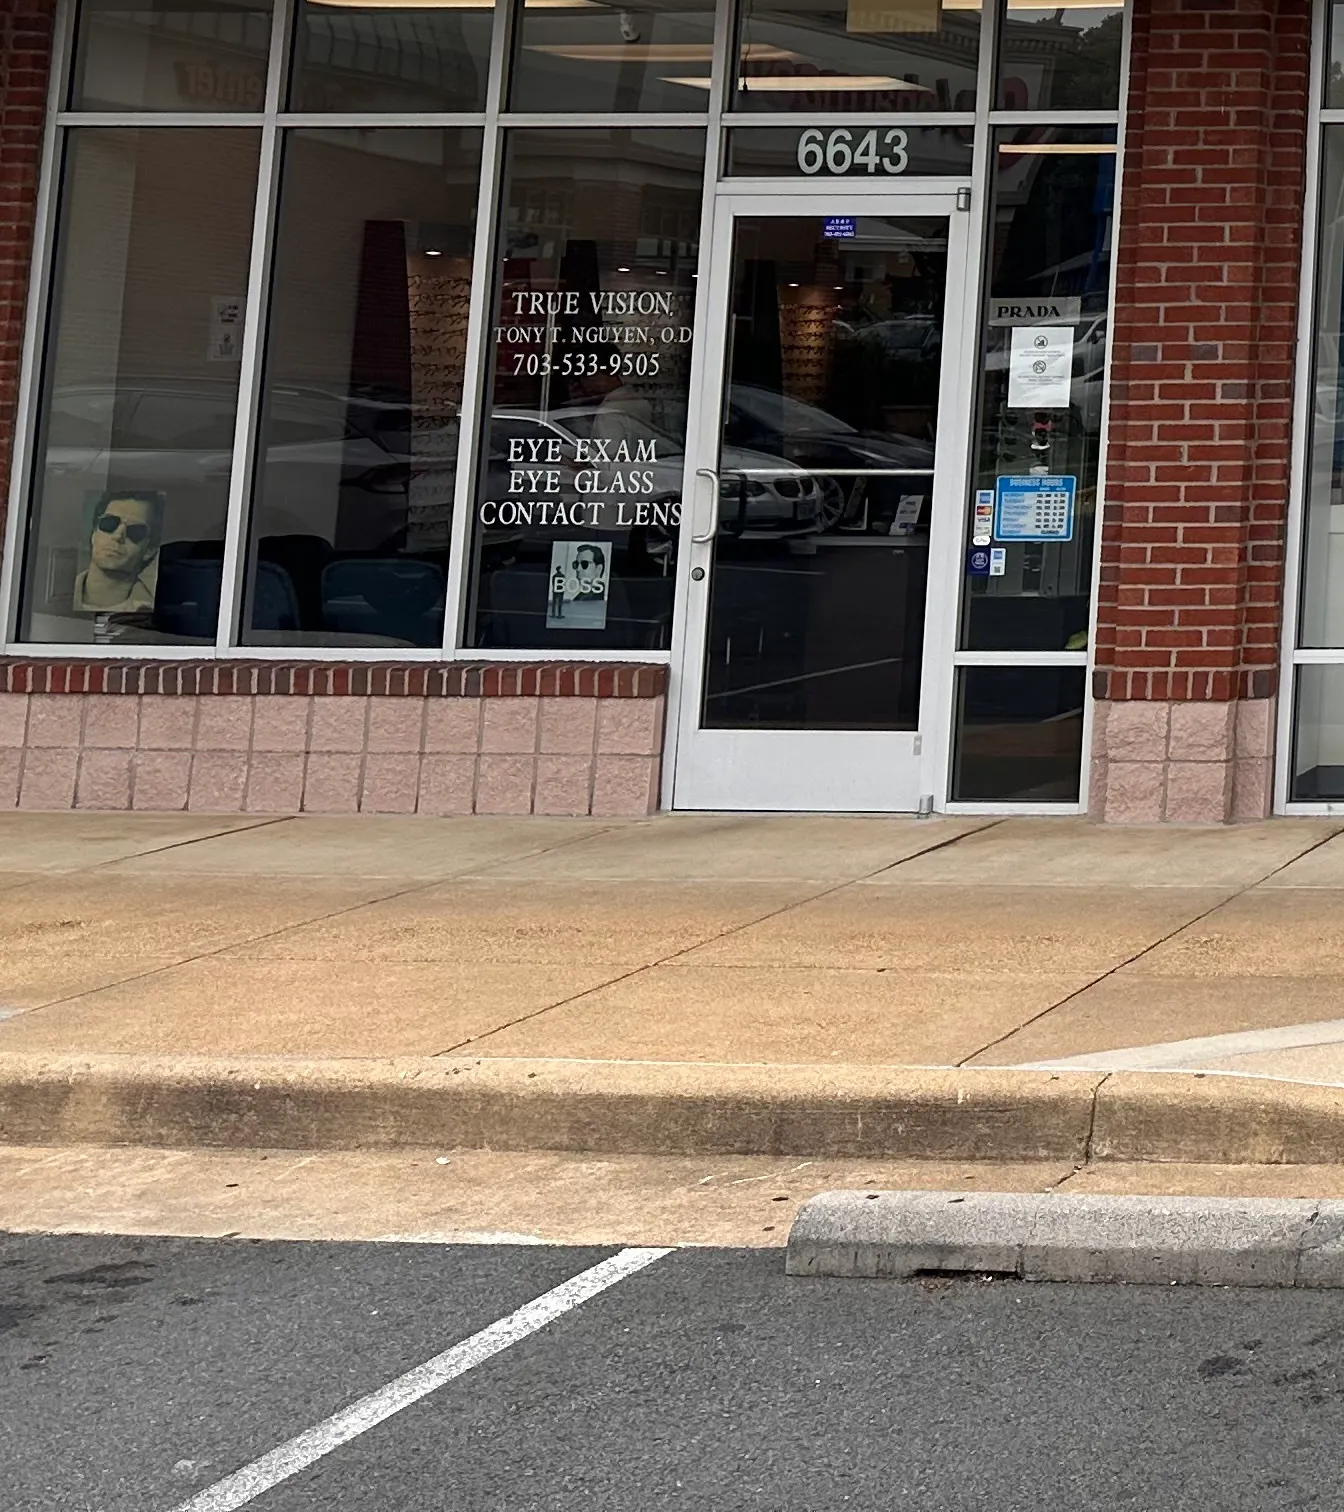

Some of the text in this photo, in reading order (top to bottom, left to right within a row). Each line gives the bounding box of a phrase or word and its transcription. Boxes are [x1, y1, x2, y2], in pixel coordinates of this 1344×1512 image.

[797, 128, 908, 174] 6643
[512, 291, 580, 315] TRUE
[997, 305, 1061, 318] PRADA
[494, 326, 545, 343] TONY
[550, 326, 566, 343] T.
[571, 326, 655, 346] NGUYEN,
[513, 353, 660, 377] 703-533-9505
[507, 438, 658, 463] EYE EXAM
[508, 470, 654, 494] EYE GLASS
[479, 501, 683, 526] CONTACT LENS
[553, 577, 604, 593] BOSS
